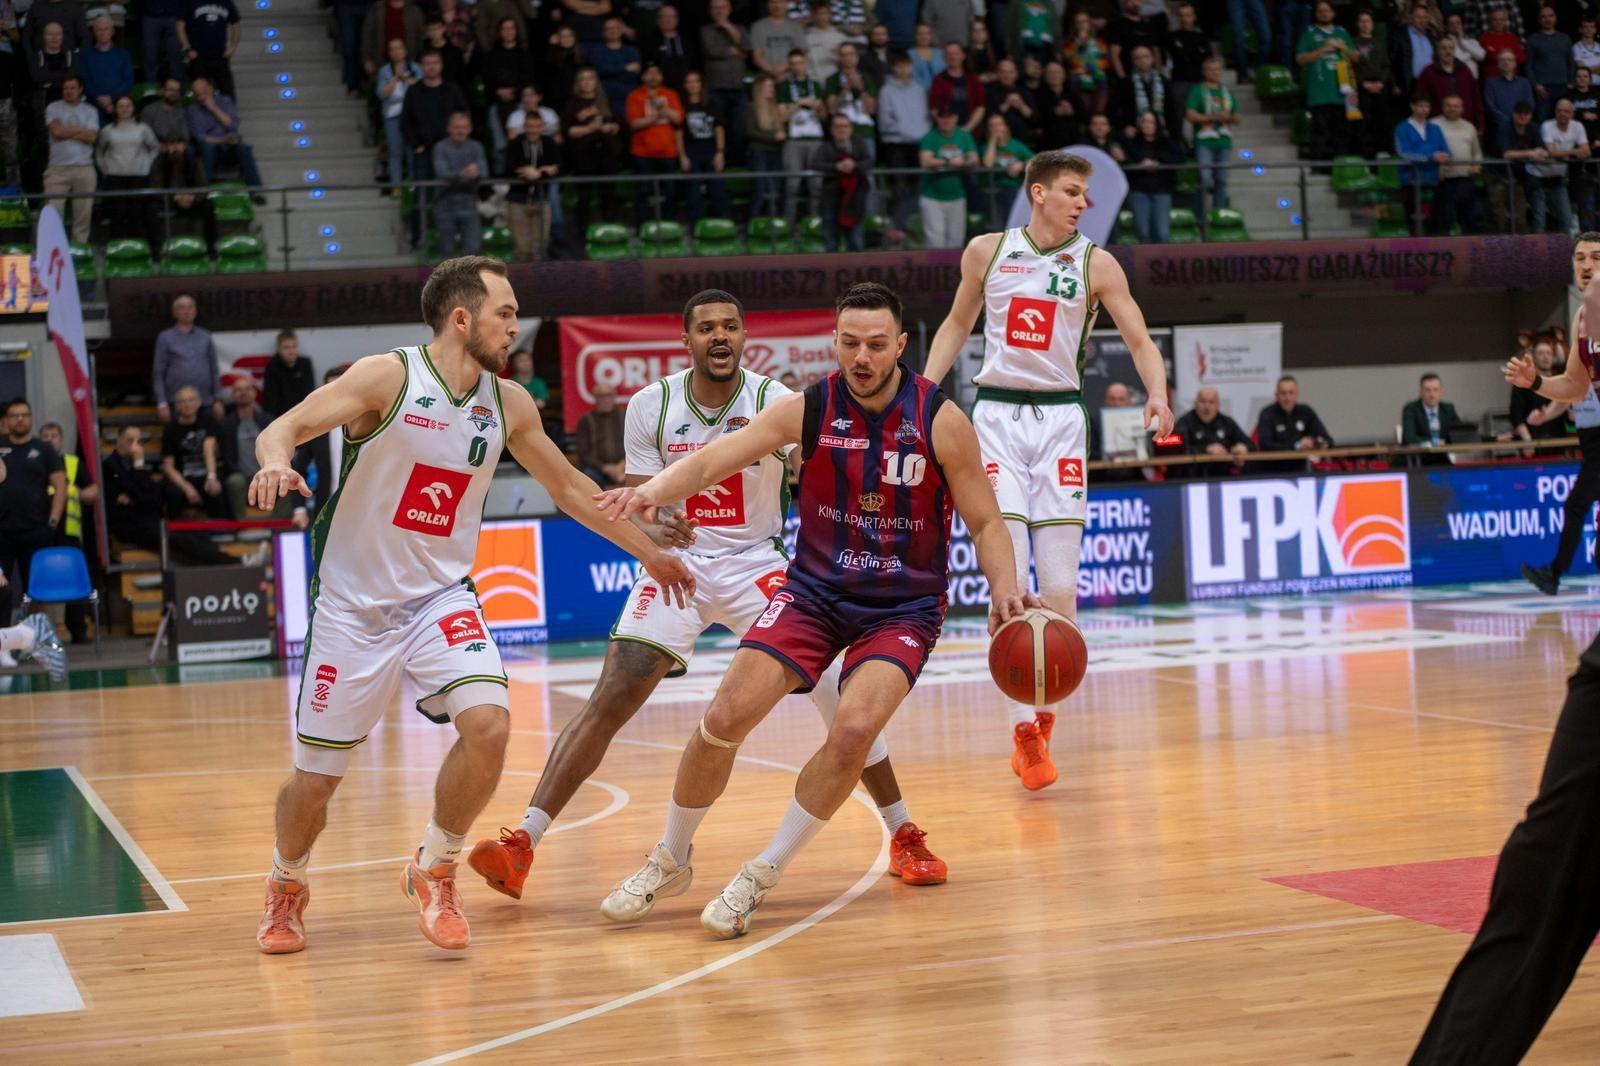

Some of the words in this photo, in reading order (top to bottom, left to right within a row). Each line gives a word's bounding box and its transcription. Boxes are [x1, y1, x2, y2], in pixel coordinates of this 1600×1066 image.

[1046, 272, 1077, 299] 13
[1011, 330, 1045, 343] ORLEN
[593, 356, 689, 388] ORLE
[415, 396, 436, 408] 4F
[406, 416, 428, 427] ORLEN
[830, 418, 854, 430] 4F
[675, 424, 690, 435] 4F
[820, 437, 843, 446] ORLEN
[468, 436, 488, 467] 0
[881, 451, 926, 486] 10
[407, 508, 450, 526] ORLEN
[695, 508, 736, 518] ORLEN
[818, 505, 841, 522] KING
[844, 513, 924, 532] APARTAMENTY
[1086, 499, 1151, 529] FIRM:
[1188, 477, 1346, 584] LFPK
[1448, 508, 1545, 540] WADIUM,
[1080, 532, 1154, 564] MOWY,
[882, 559, 902, 569] 2050
[1078, 566, 1153, 598] SINGU
[452, 629, 480, 639] ORLEN
[898, 636, 919, 648] 4F
[317, 670, 336, 678] ORLEN
